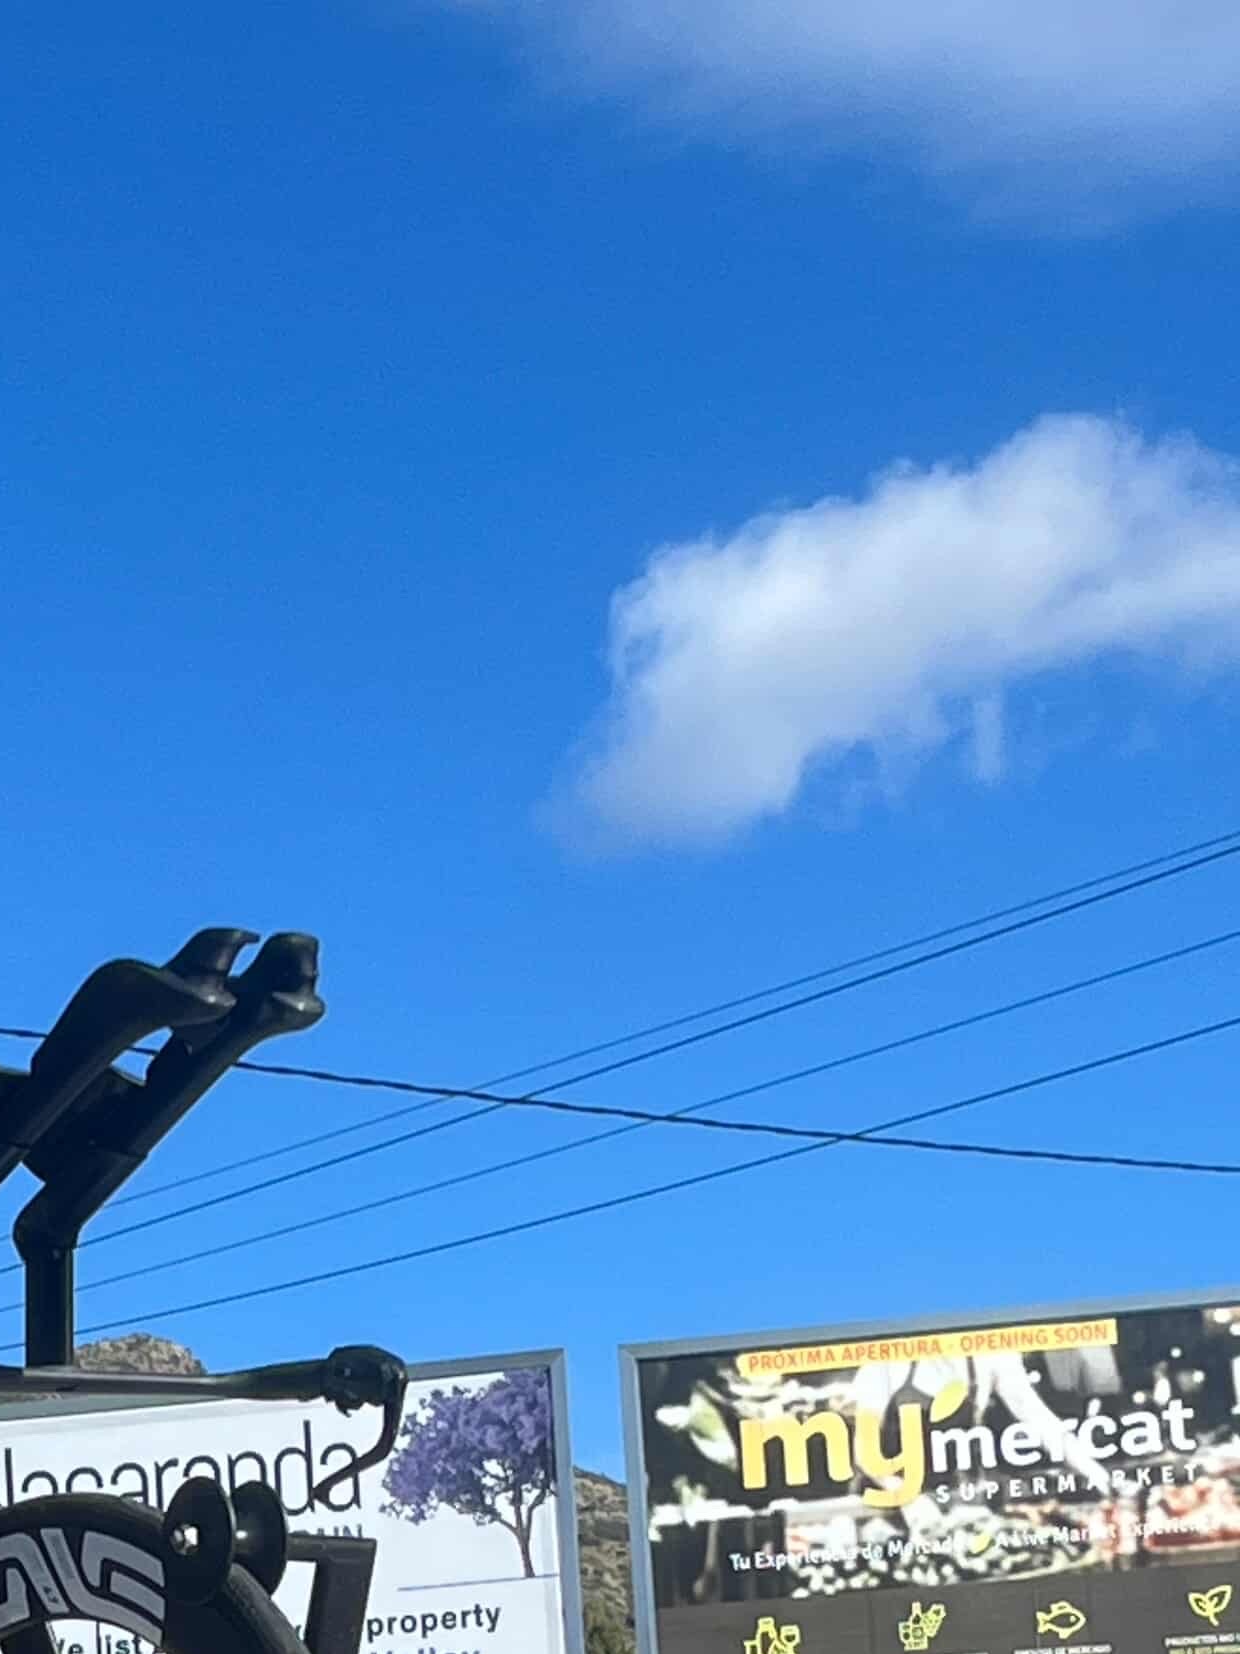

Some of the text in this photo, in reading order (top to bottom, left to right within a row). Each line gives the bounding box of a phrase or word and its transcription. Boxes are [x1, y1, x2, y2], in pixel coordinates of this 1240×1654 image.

[841, 1337, 943, 1364] APERTURA
[959, 1327, 1049, 1353] OPENING
[1054, 1324, 1109, 1344] SOON
[728, 1553, 752, 1571] Tu
[366, 1603, 502, 1644] property
